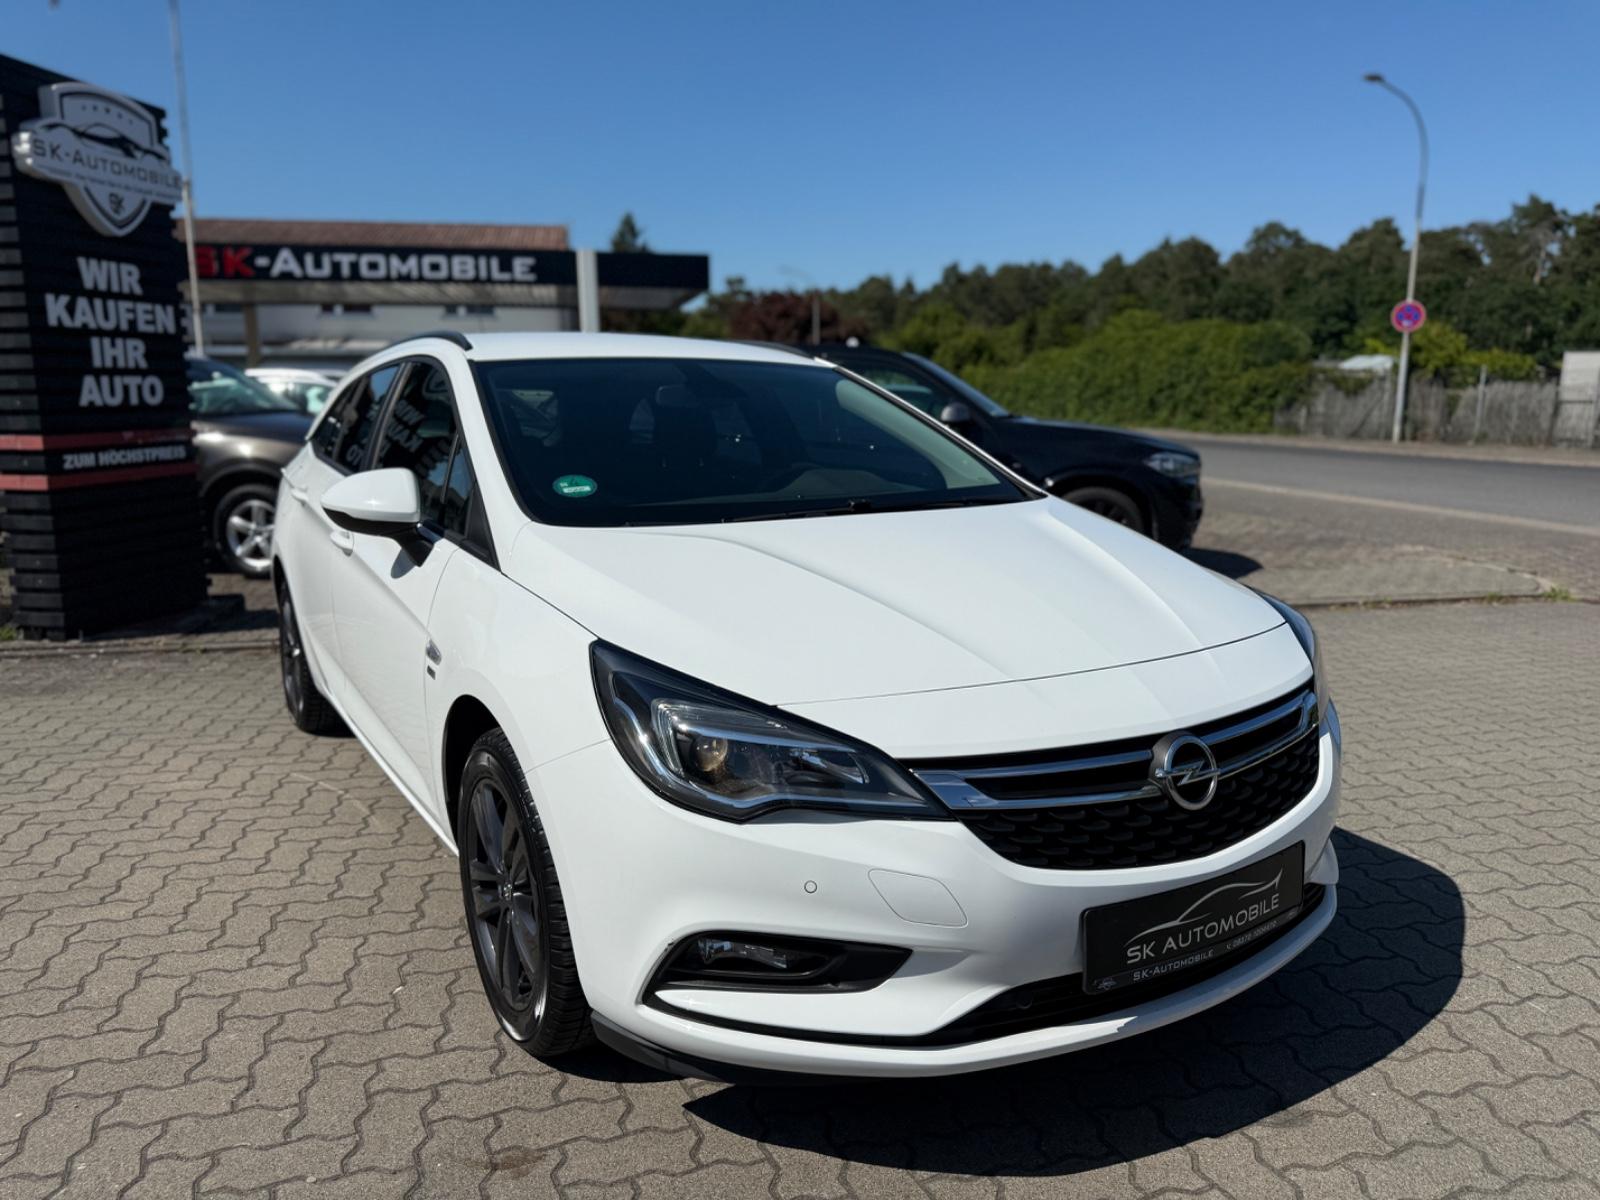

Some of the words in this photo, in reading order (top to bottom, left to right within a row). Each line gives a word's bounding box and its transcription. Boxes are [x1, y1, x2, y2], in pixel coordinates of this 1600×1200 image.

[77, 256, 142, 295] WIR
[44, 293, 176, 334] KAUFEN
[90, 336, 148, 369] IHR
[79, 374, 164, 408] AUTO
[62, 452, 96, 470] ZUM
[1126, 941, 1156, 964] SK
[1162, 893, 1280, 954] AUTOMOBILE
[1133, 949, 1215, 981] SK-AUTOMOBILE
